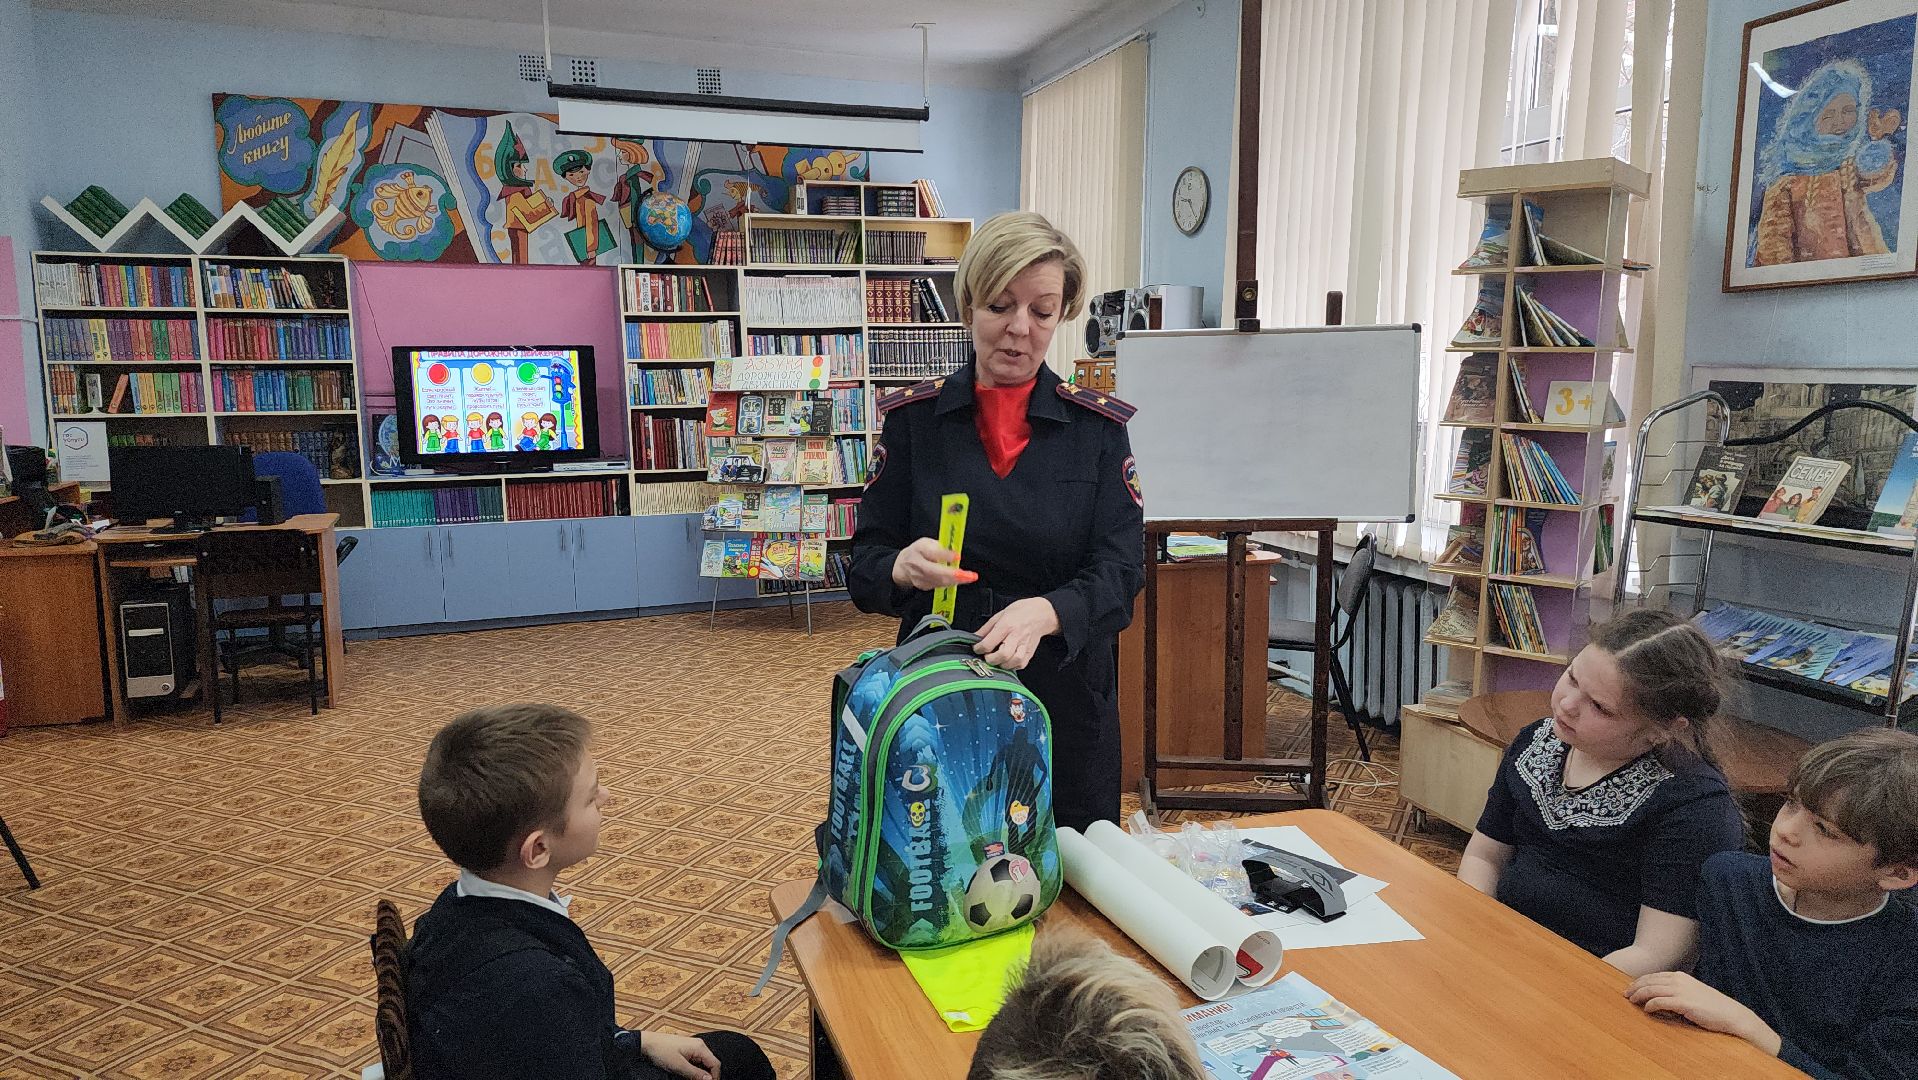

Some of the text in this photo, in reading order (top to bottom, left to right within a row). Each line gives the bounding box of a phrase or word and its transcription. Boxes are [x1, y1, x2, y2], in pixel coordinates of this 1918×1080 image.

[227, 112, 292, 154] Любите
[243, 136, 289, 166] книгу
[736, 370, 803, 382] ДОРОЖНОГО
[744, 357, 803, 371] АЗБУКА
[1555, 387, 1596, 416] 3+
[1790, 463, 1834, 484] СЕМЬЯ
[831, 740, 858, 840] FOOTBALL
